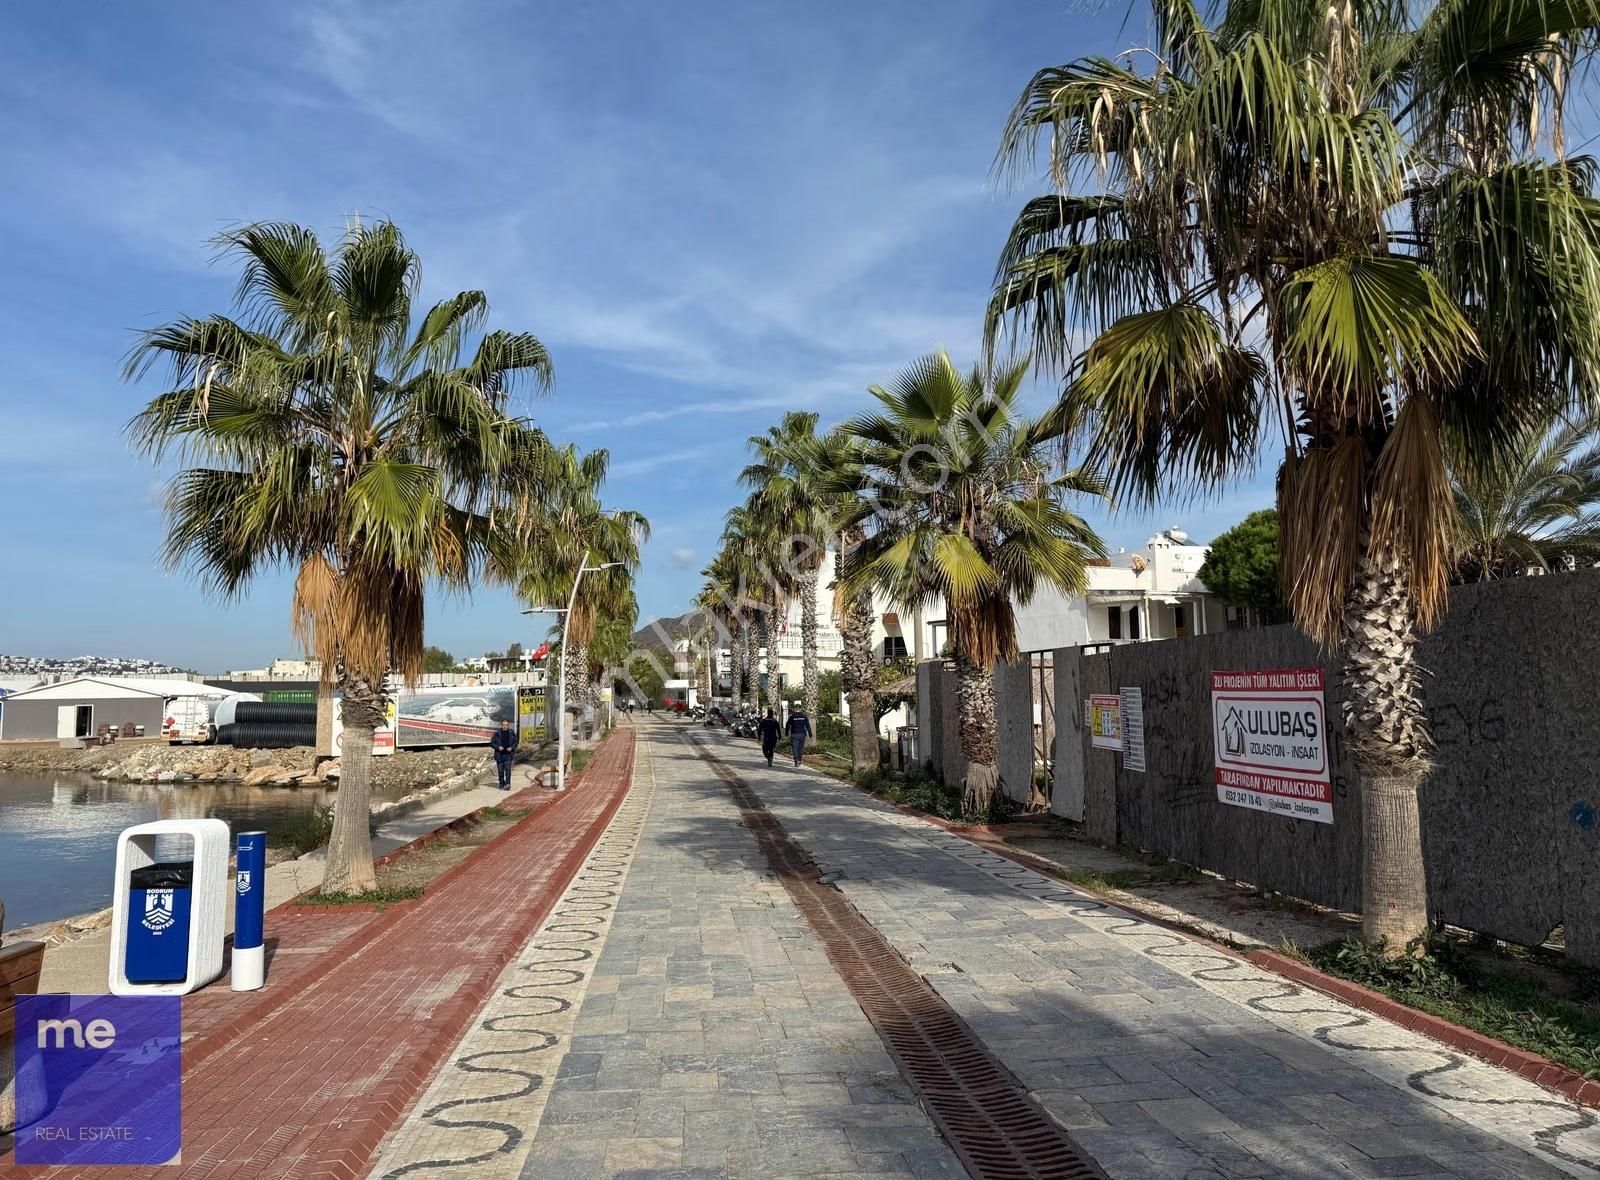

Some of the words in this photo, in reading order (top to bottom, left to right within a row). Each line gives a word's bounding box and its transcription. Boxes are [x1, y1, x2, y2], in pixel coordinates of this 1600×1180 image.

[1223, 672, 1251, 688] PROJENİN
[1253, 672, 1268, 688] TÜM
[1269, 674, 1296, 689] YALITIM
[1297, 669, 1321, 690] İŞLERİ
[1248, 710, 1318, 741] ULUBAŞ
[1250, 742, 1285, 758] İZOLASYON
[1220, 771, 1261, 791] TARAFINDAN
[1262, 777, 1325, 799] YAPILMAKTADIR
